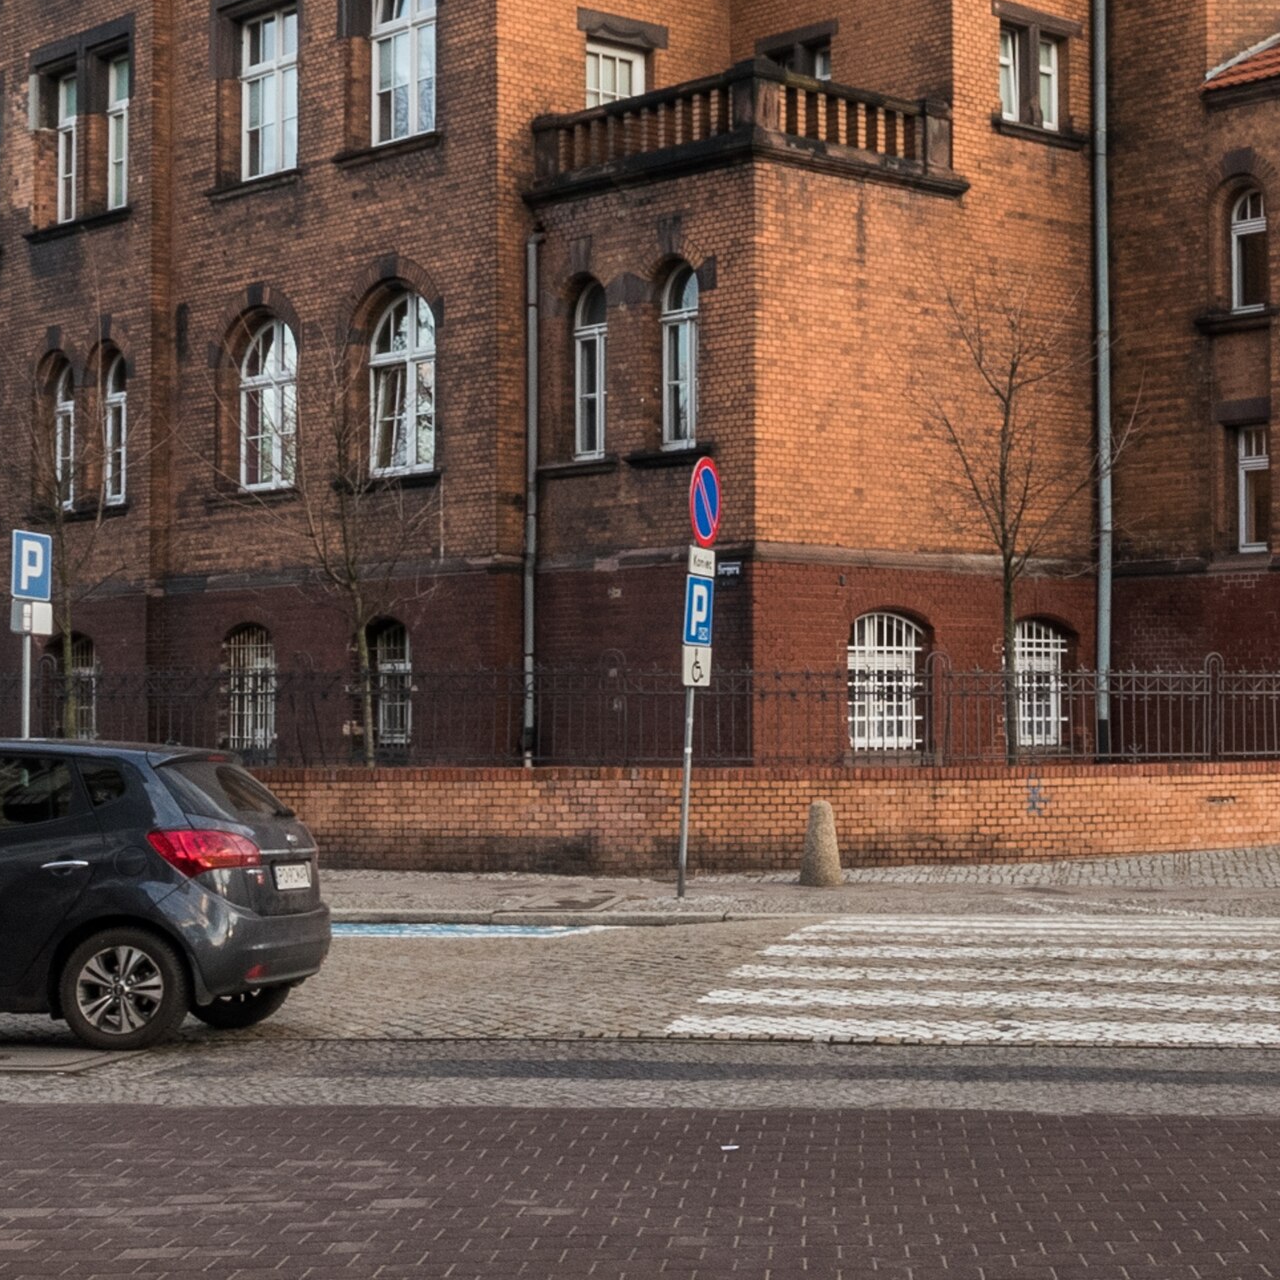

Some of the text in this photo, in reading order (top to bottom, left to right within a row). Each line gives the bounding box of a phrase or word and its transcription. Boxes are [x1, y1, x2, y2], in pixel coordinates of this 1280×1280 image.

[20, 539, 44, 591] P
[693, 554, 713, 571] Koniec
[690, 584, 709, 637] P
